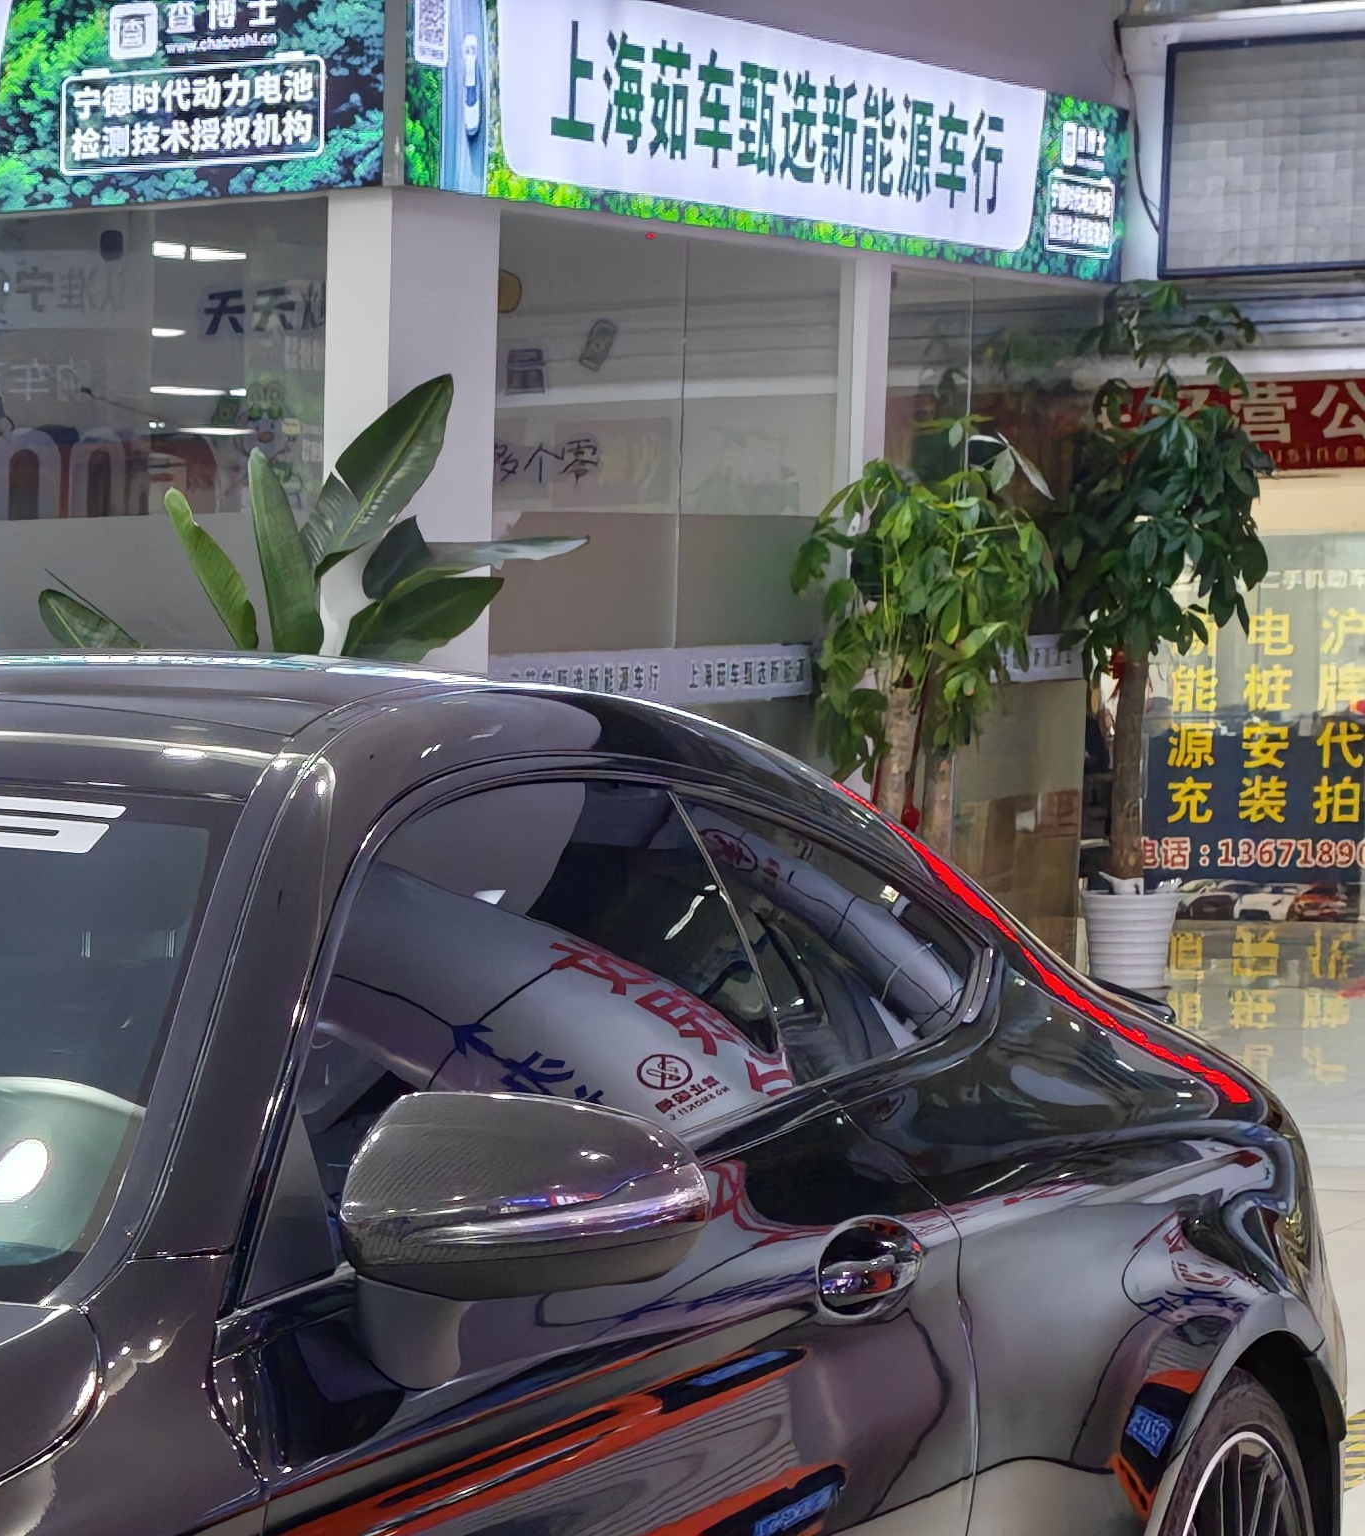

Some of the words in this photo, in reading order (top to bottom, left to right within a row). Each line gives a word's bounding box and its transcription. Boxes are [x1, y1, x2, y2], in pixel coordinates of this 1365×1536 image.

[165, 0, 278, 33] 查博士
[73, 68, 314, 121] 宁德时代动力电池
[550, 19, 1006, 214] 上海茹车甄选新能源车行
[71, 110, 314, 161] 检测技术授权机构
